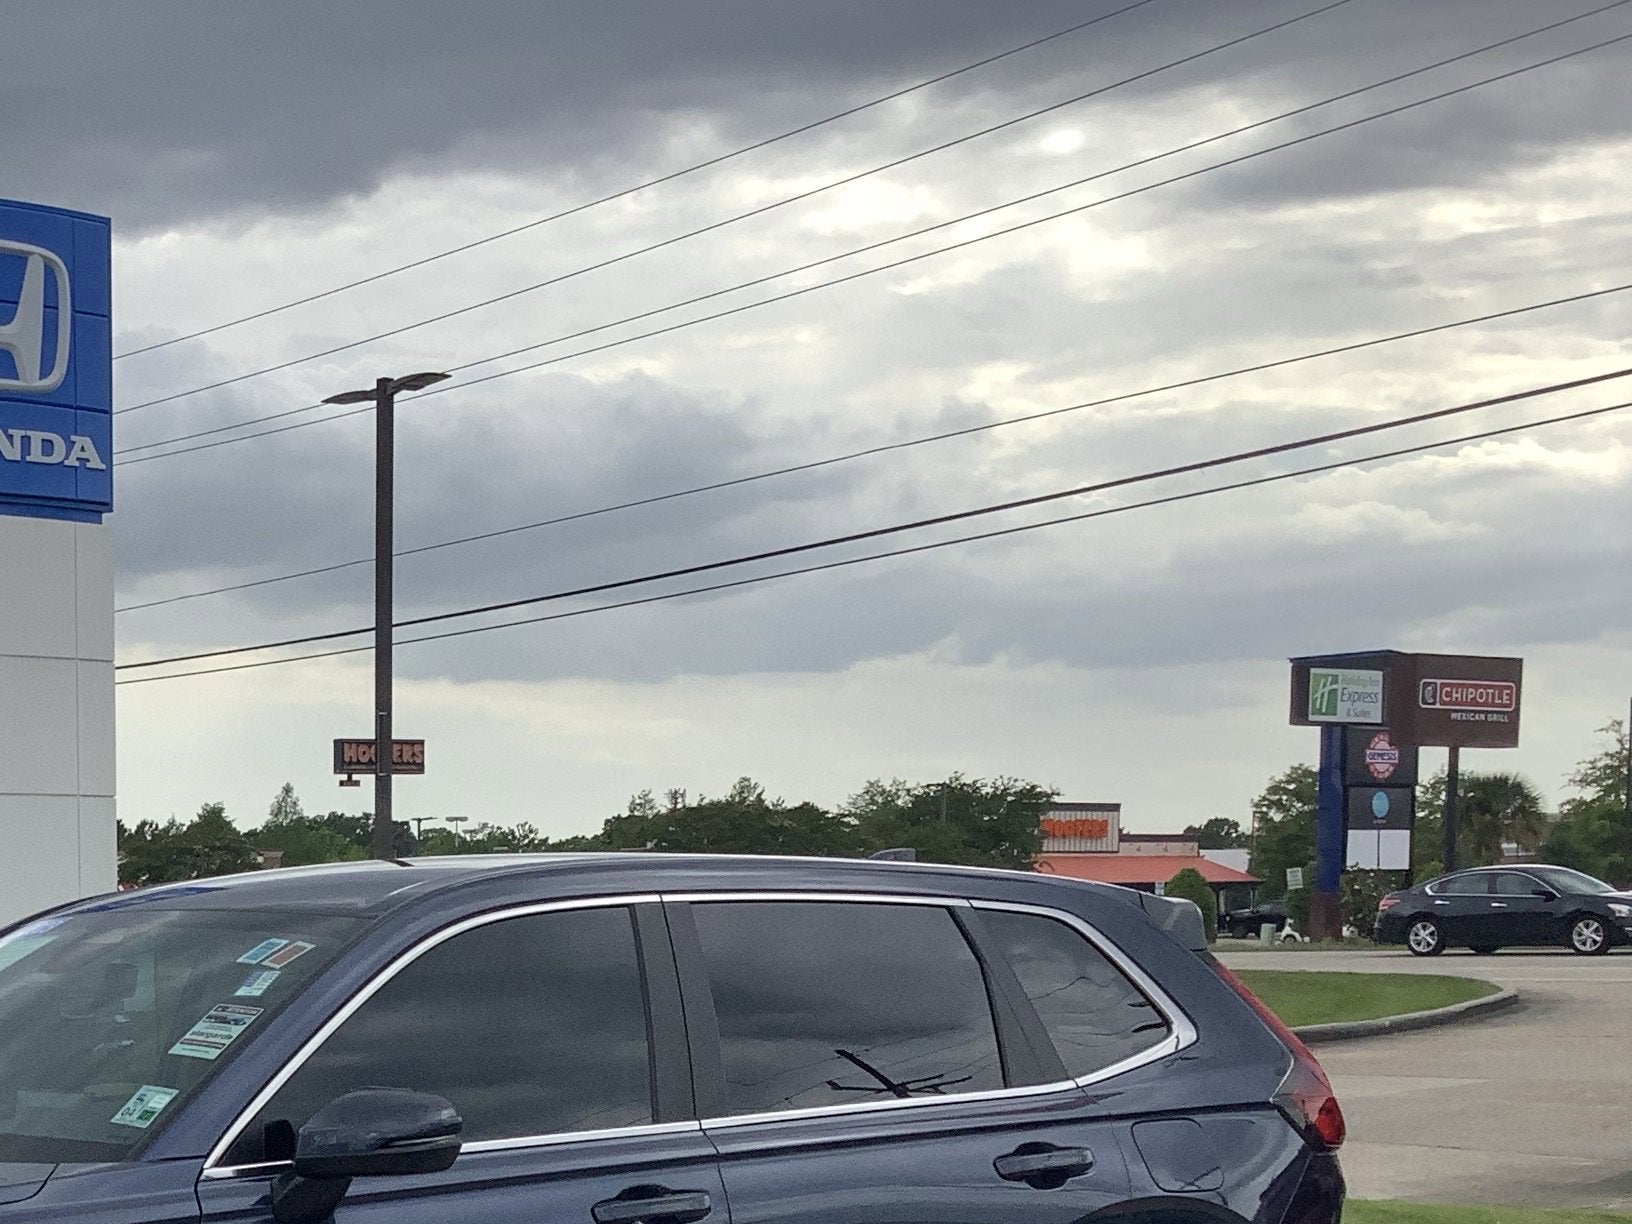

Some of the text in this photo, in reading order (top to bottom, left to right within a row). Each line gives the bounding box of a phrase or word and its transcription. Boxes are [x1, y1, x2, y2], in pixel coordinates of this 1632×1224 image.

[1340, 687, 1380, 707] Express
[1441, 687, 1511, 704] CHIPOTLE
[1451, 712, 1509, 722] MEXICAN GRILL
[1369, 752, 1397, 760] GENESIS
